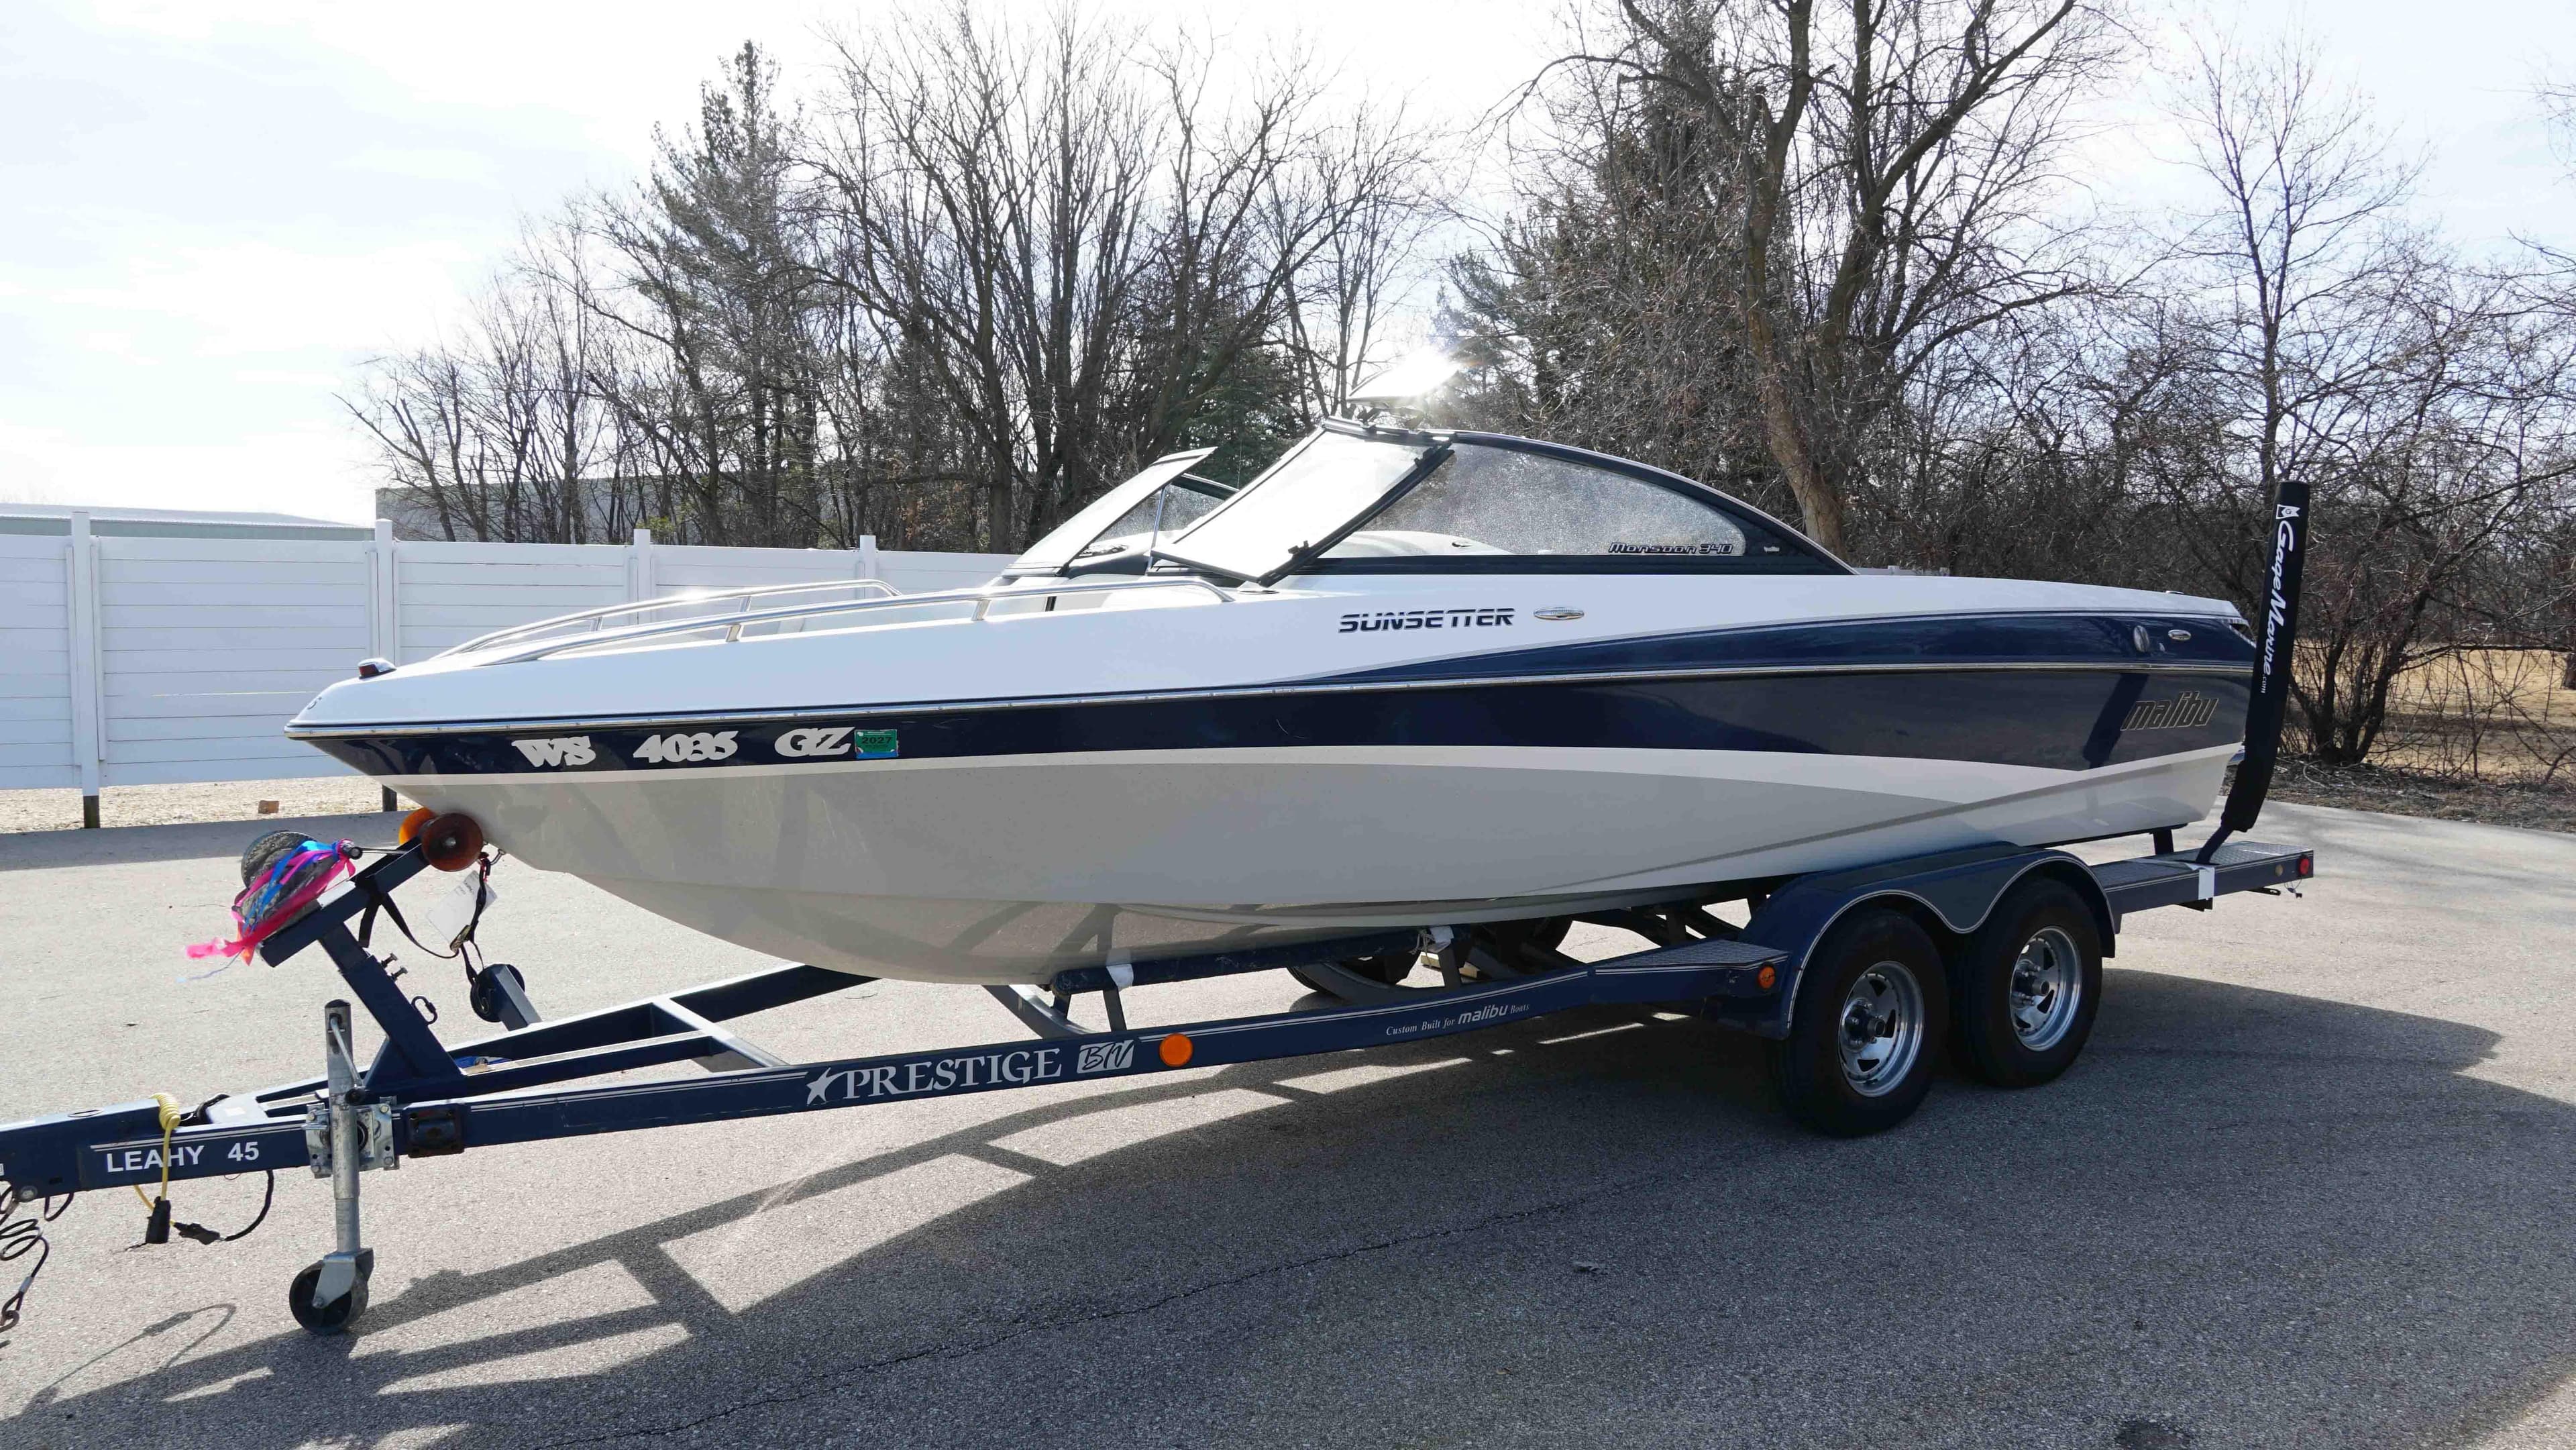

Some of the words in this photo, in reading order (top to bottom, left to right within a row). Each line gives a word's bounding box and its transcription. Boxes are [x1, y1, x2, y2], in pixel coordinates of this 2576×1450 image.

[1609, 542, 1697, 554] Monsoon
[1699, 543, 1733, 554] 340
[1338, 608, 1515, 633] SUNSETTER
[2119, 691, 2219, 731] malibu
[511, 735, 596, 767] WS
[774, 727, 855, 757] GZ
[1386, 1025, 1417, 1035] Custom
[1421, 1020, 1441, 1031] Built
[1442, 1017, 1456, 1030] for
[1458, 1004, 1508, 1025] malibu
[1510, 1004, 1529, 1015] Boats
[839, 1048, 1062, 1099] PRESTIGE
[107, 1145, 204, 1172] LEAHY
[227, 1141, 260, 1161] 45
